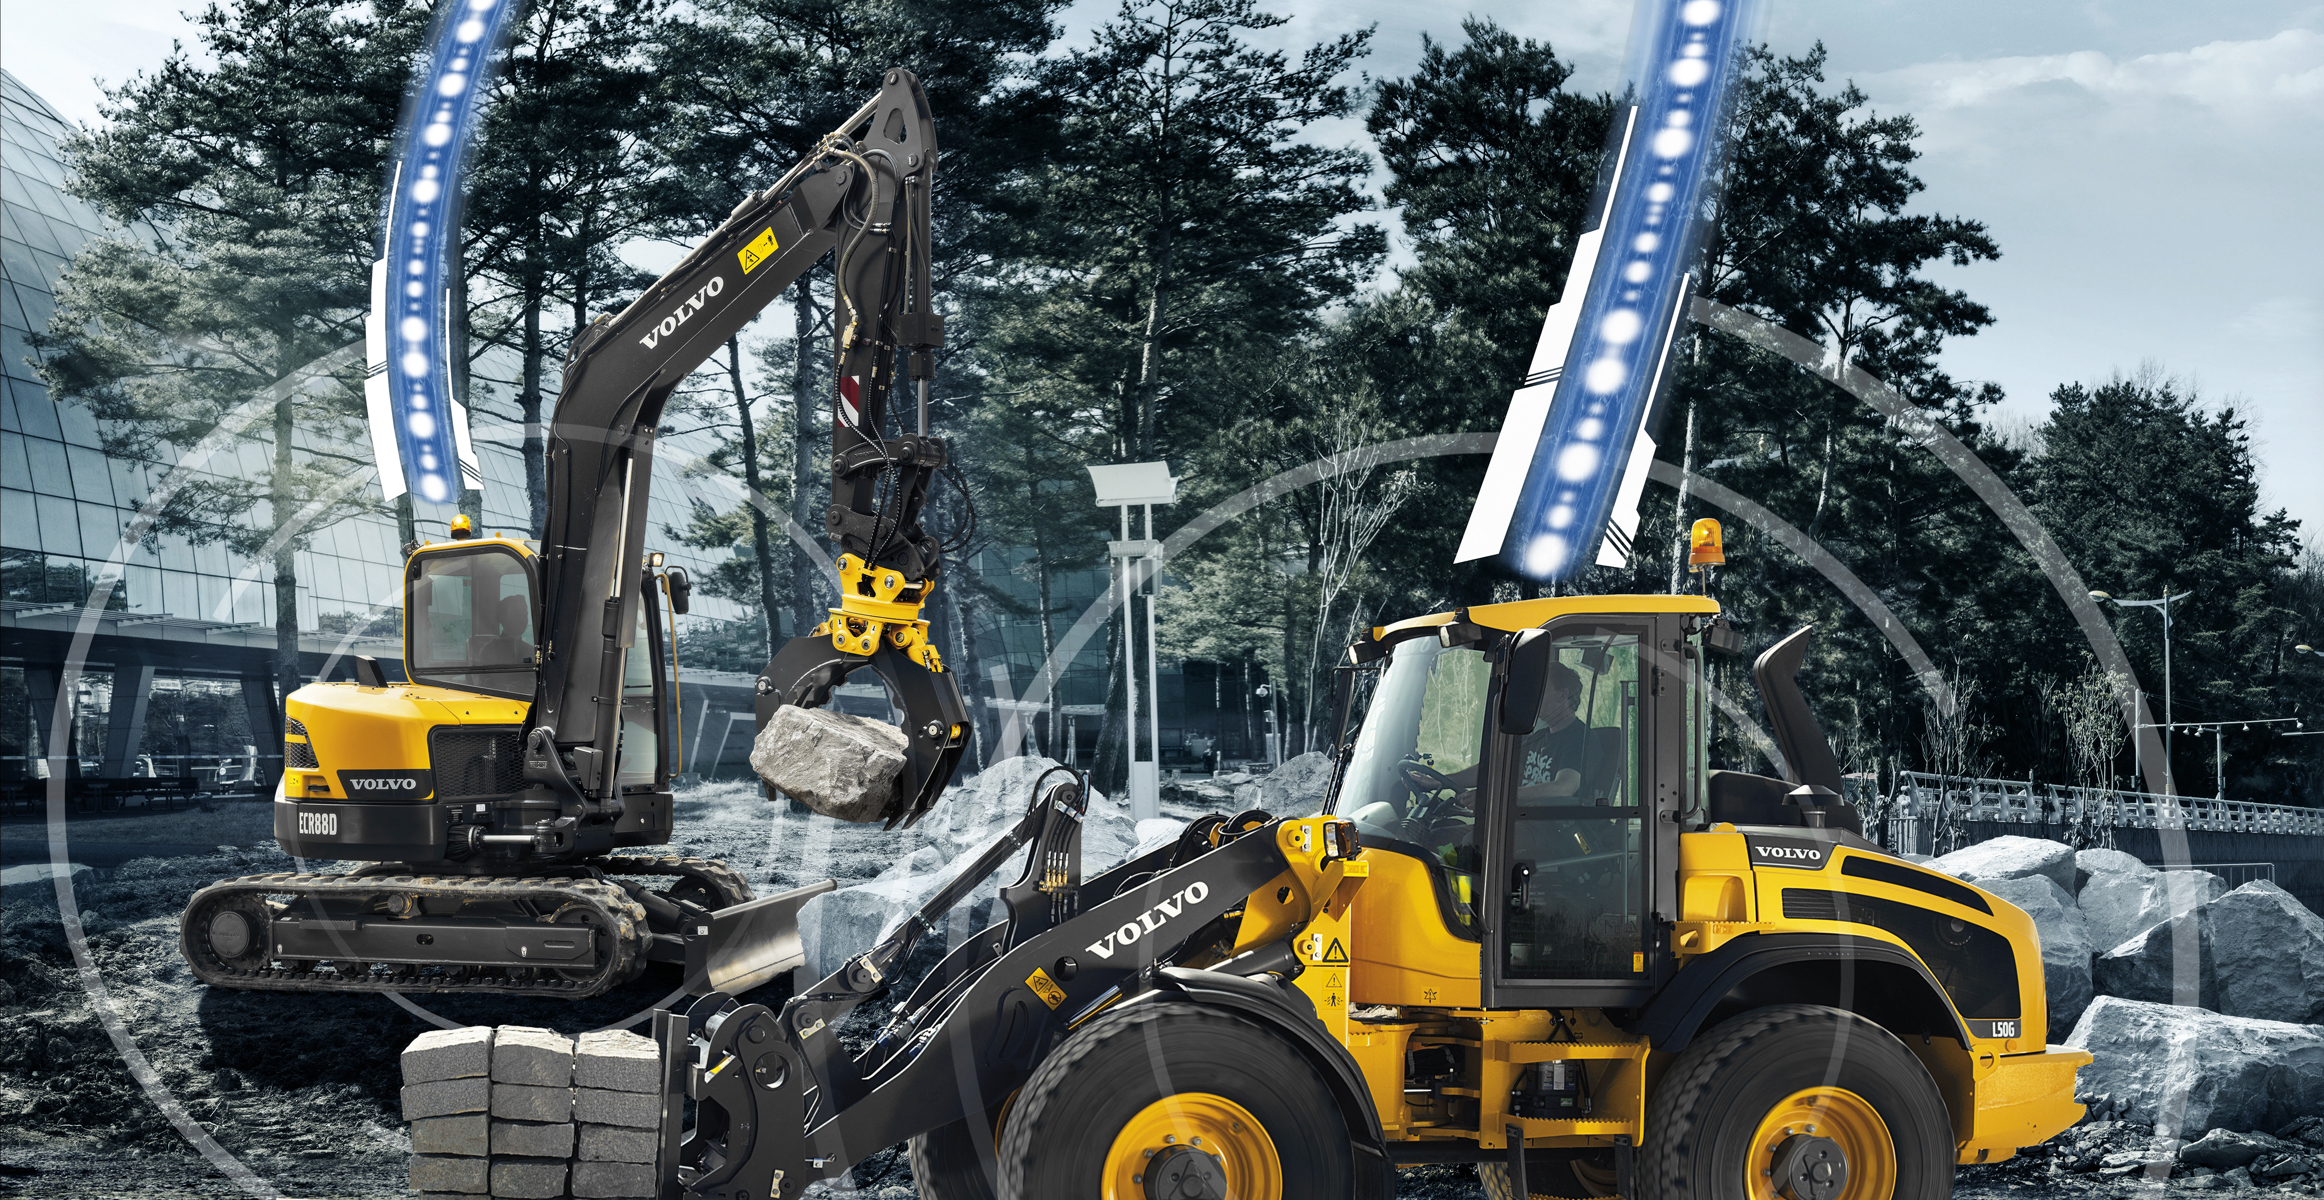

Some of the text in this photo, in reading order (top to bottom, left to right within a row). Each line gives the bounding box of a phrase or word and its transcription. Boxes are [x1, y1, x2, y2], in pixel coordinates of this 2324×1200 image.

[639, 276, 724, 350] VOLVO
[350, 778, 417, 790] VOLVO
[299, 811, 338, 836] ECR88D
[1755, 846, 1821, 860] VOLVO
[1085, 881, 1209, 960] VOLVO
[1992, 1021, 2015, 1038] L50G
